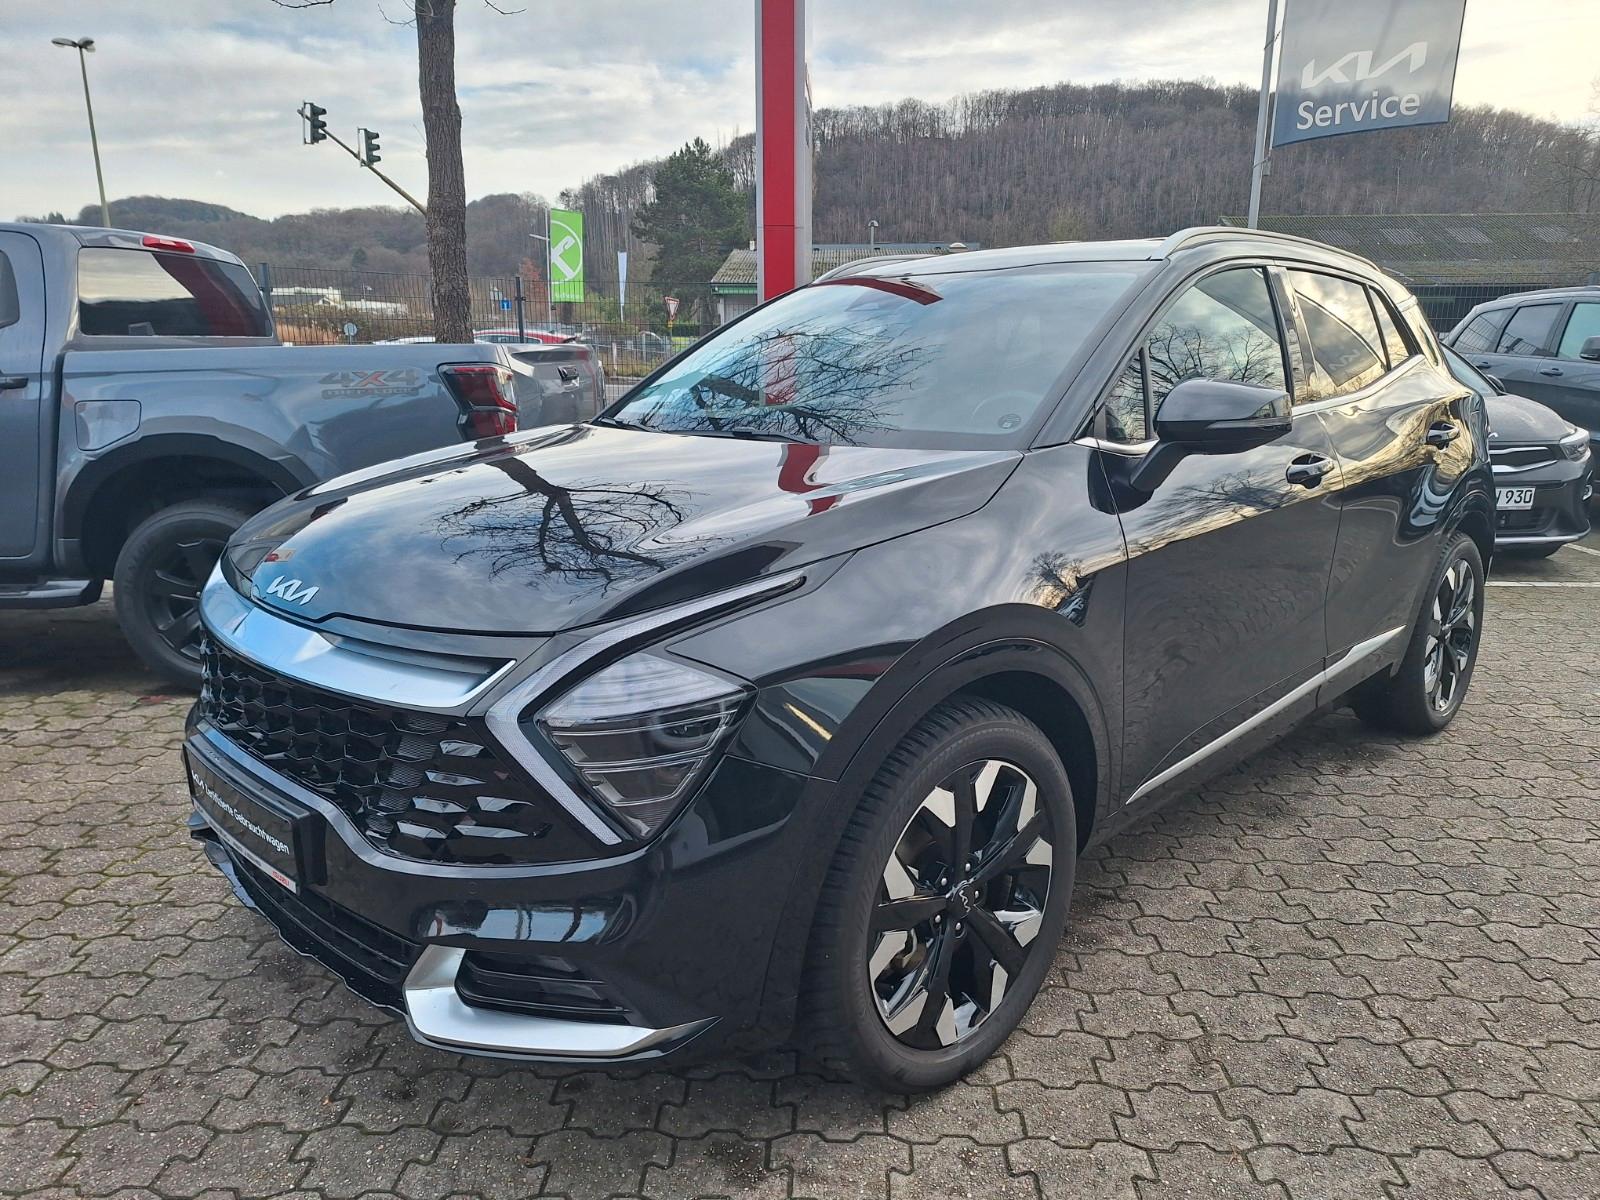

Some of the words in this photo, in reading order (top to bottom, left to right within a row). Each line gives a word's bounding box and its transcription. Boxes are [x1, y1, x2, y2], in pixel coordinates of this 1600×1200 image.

[1301, 42, 1427, 88] KIA
[1297, 90, 1420, 129] Service
[1505, 490, 1533, 504] 930
[266, 575, 320, 605] KIA
[234, 808, 290, 855] Gebrauchtwagen
